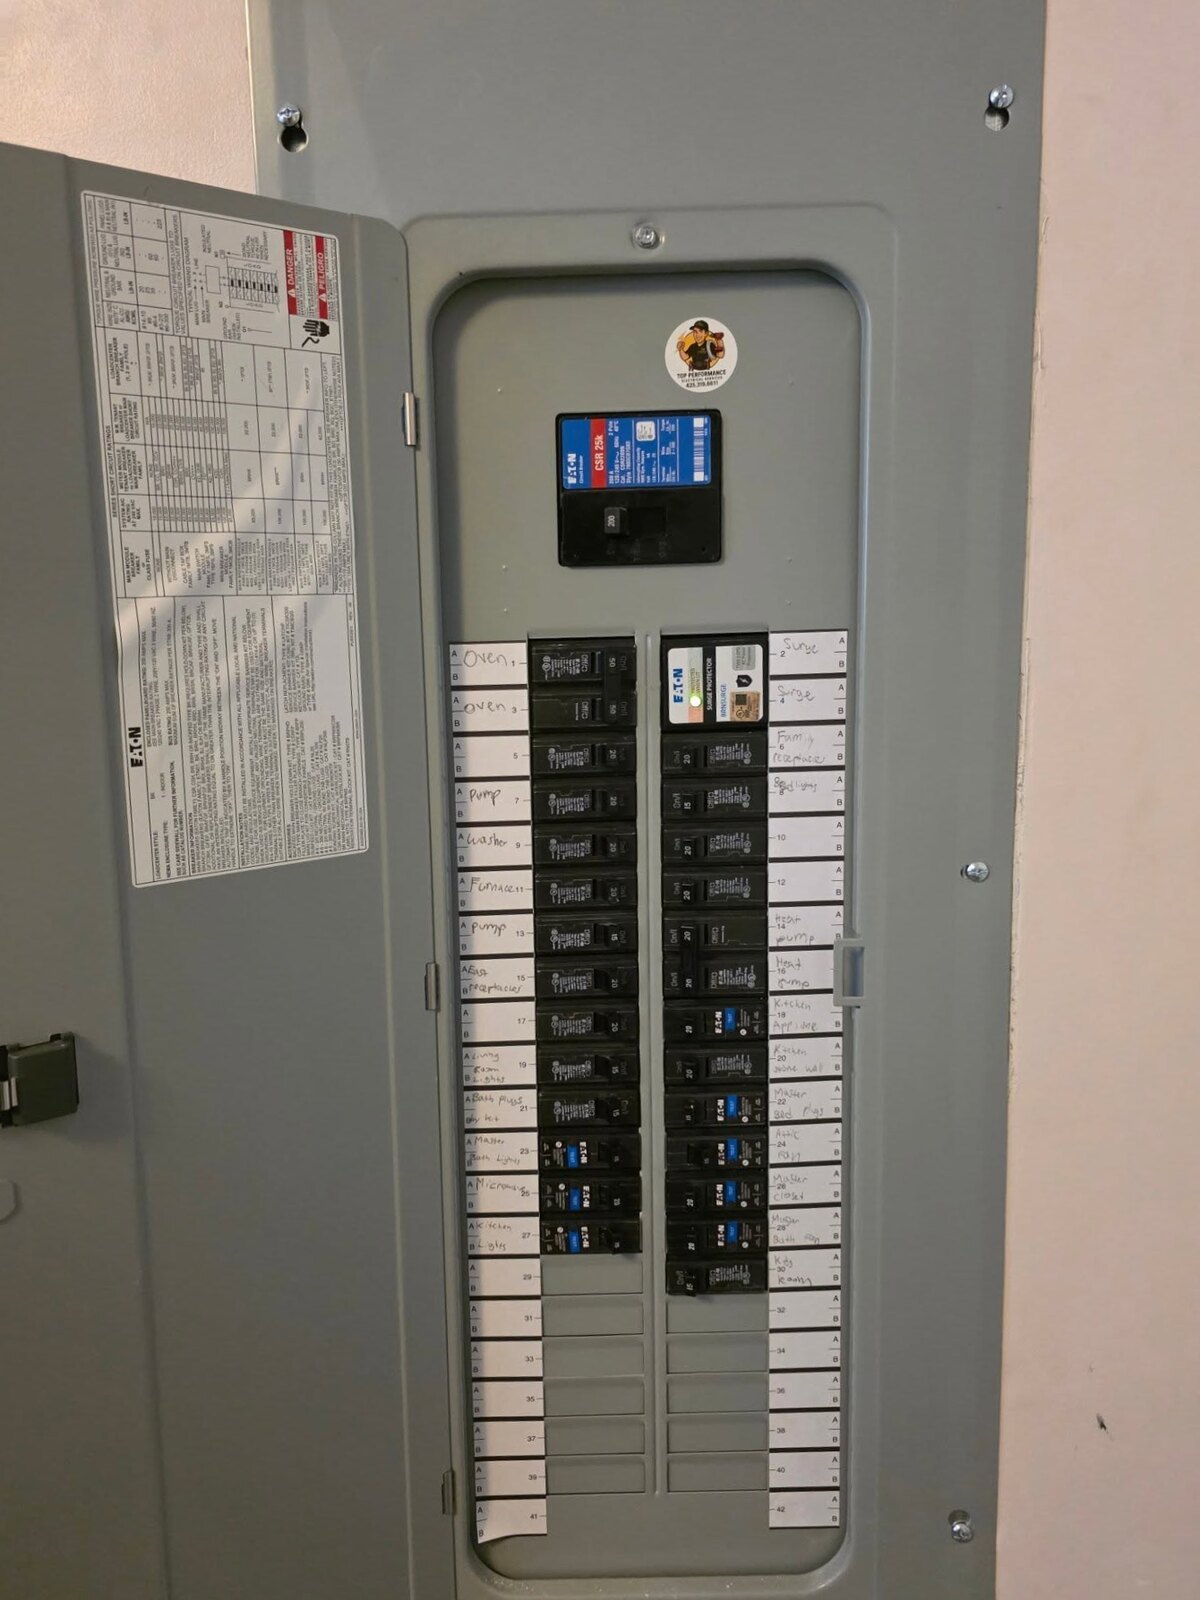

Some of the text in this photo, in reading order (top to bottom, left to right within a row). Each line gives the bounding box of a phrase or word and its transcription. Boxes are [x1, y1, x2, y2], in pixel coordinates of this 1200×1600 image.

[286, 248, 295, 286] DANGER
[317, 252, 325, 290] PELIGRO
[688, 369, 726, 378] PERFORMANCE
[594, 434, 604, 471] CSR 25k
[607, 515, 616, 527] 200
[463, 650, 508, 668] Oven
[673, 668, 683, 703] EATON
[478, 1529, 484, 1537] B
